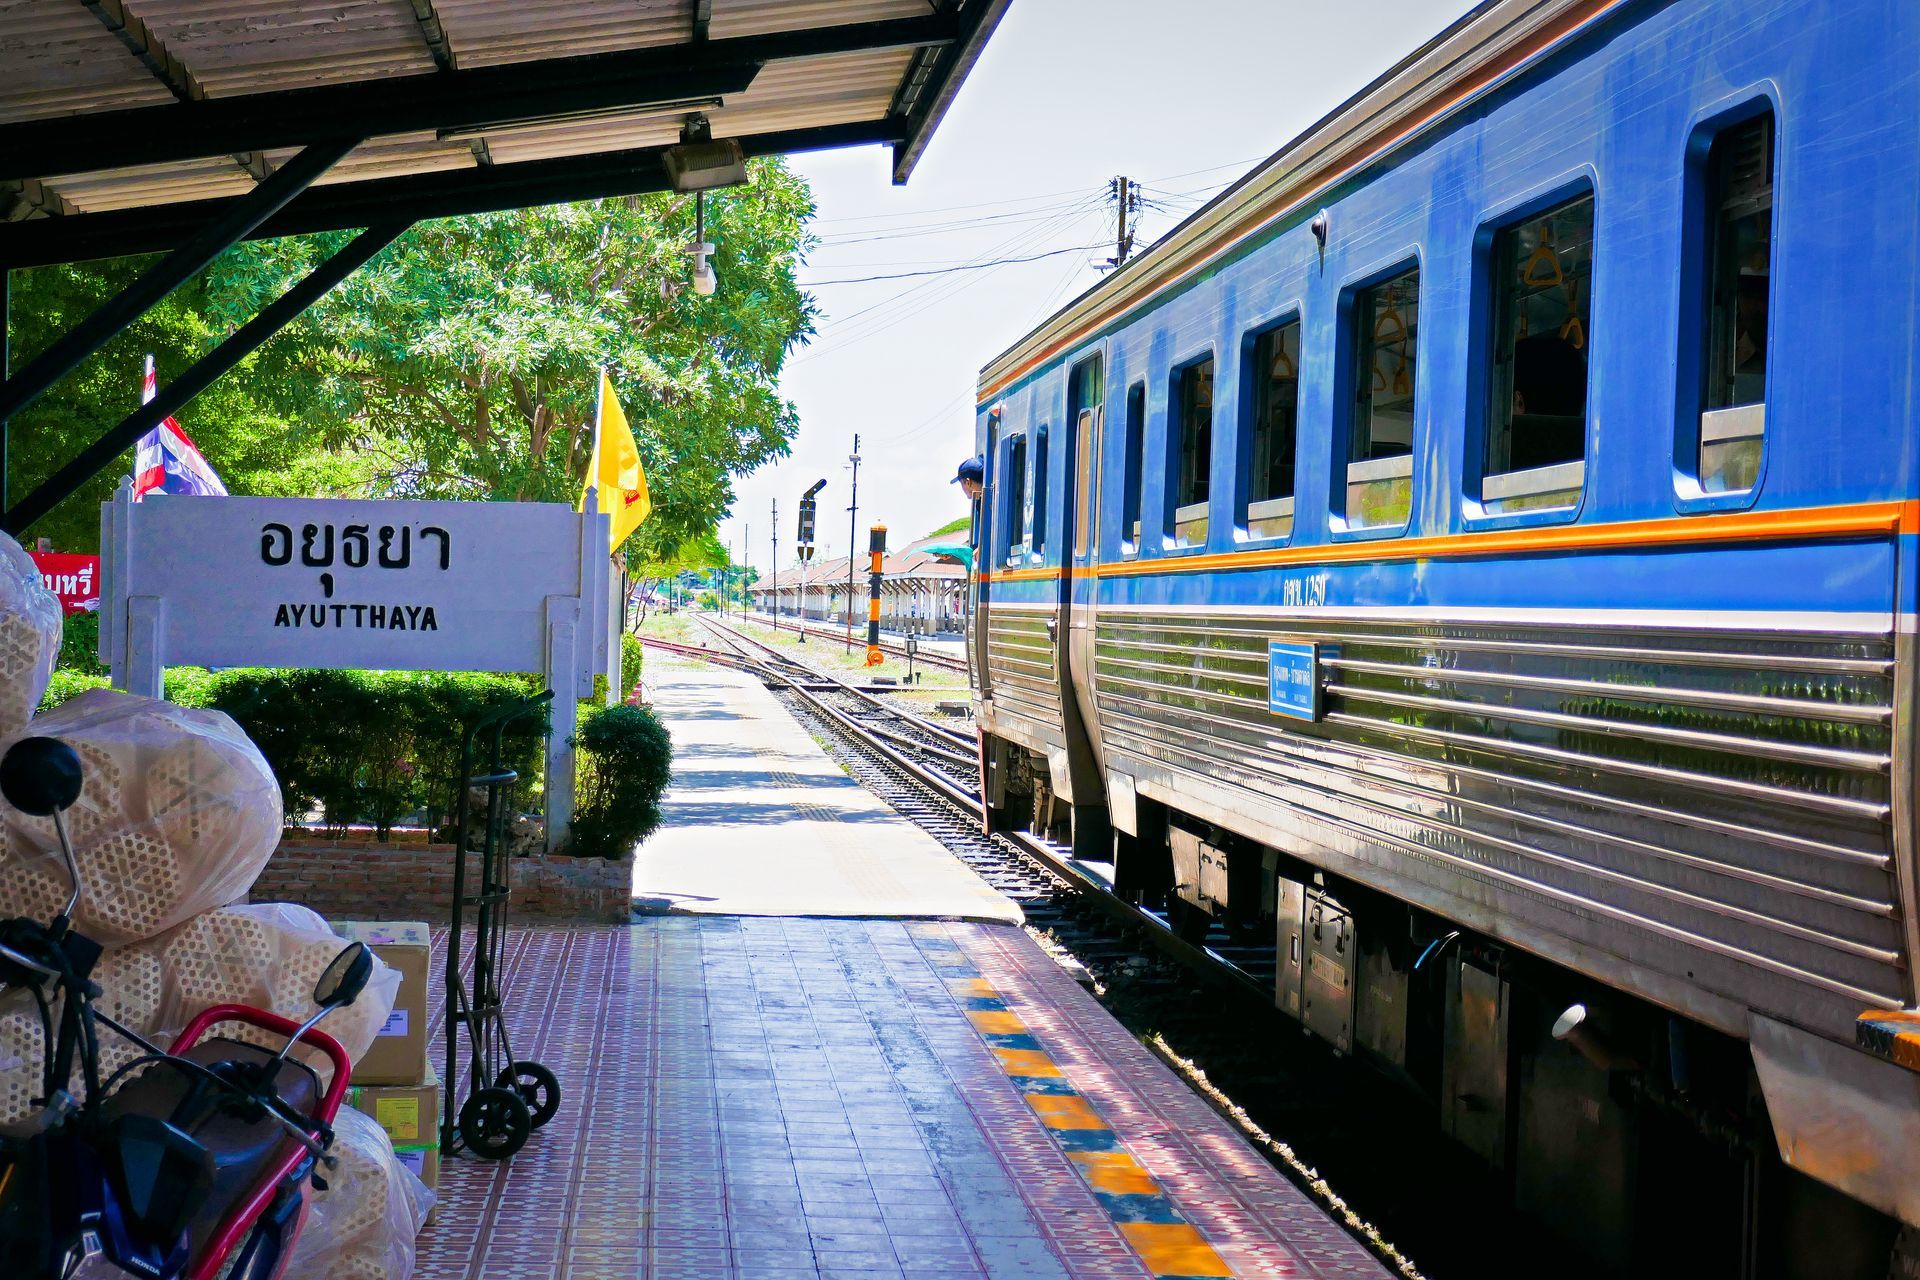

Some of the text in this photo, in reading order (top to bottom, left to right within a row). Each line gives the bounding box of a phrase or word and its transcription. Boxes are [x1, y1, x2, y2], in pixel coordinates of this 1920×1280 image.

[261, 523, 450, 598] อยุธยา
[40, 563, 93, 595] บหรี่
[1305, 573, 1326, 606] 1250
[274, 603, 438, 630] AYUTTHAYA
[131, 1256, 160, 1275] HONDA
